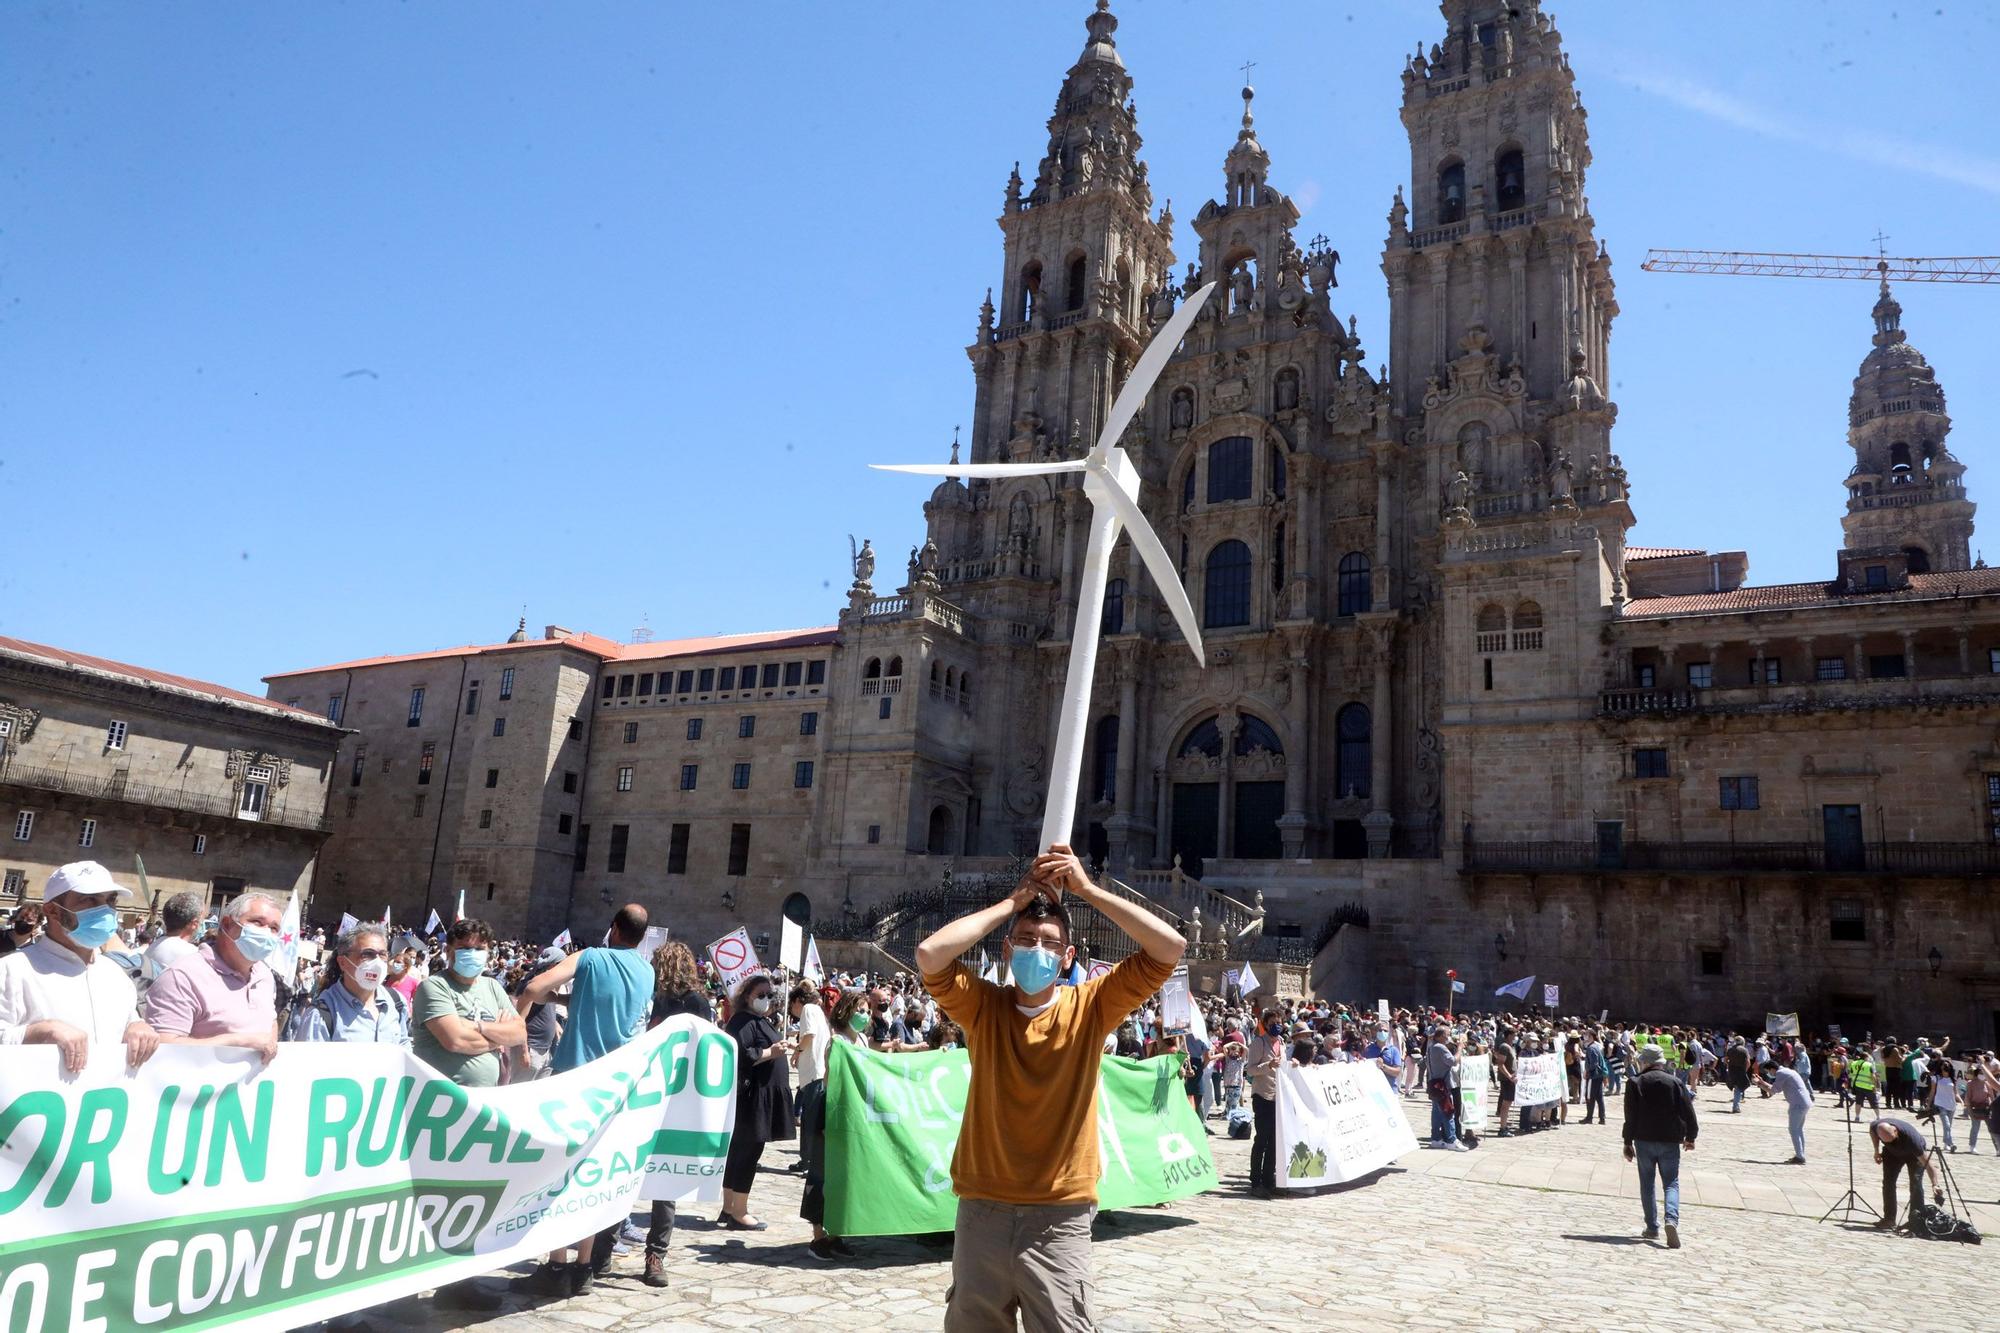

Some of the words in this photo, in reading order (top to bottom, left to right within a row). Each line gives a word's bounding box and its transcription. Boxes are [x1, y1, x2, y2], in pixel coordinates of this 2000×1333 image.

[147, 1080, 275, 1195] UN
[304, 1076, 545, 1177] RURAL
[495, 1188, 612, 1237] FEDERACIÓN
[644, 1161, 725, 1177] GALEGA
[132, 1224, 279, 1325] CON
[280, 1194, 486, 1290] FUTURO
